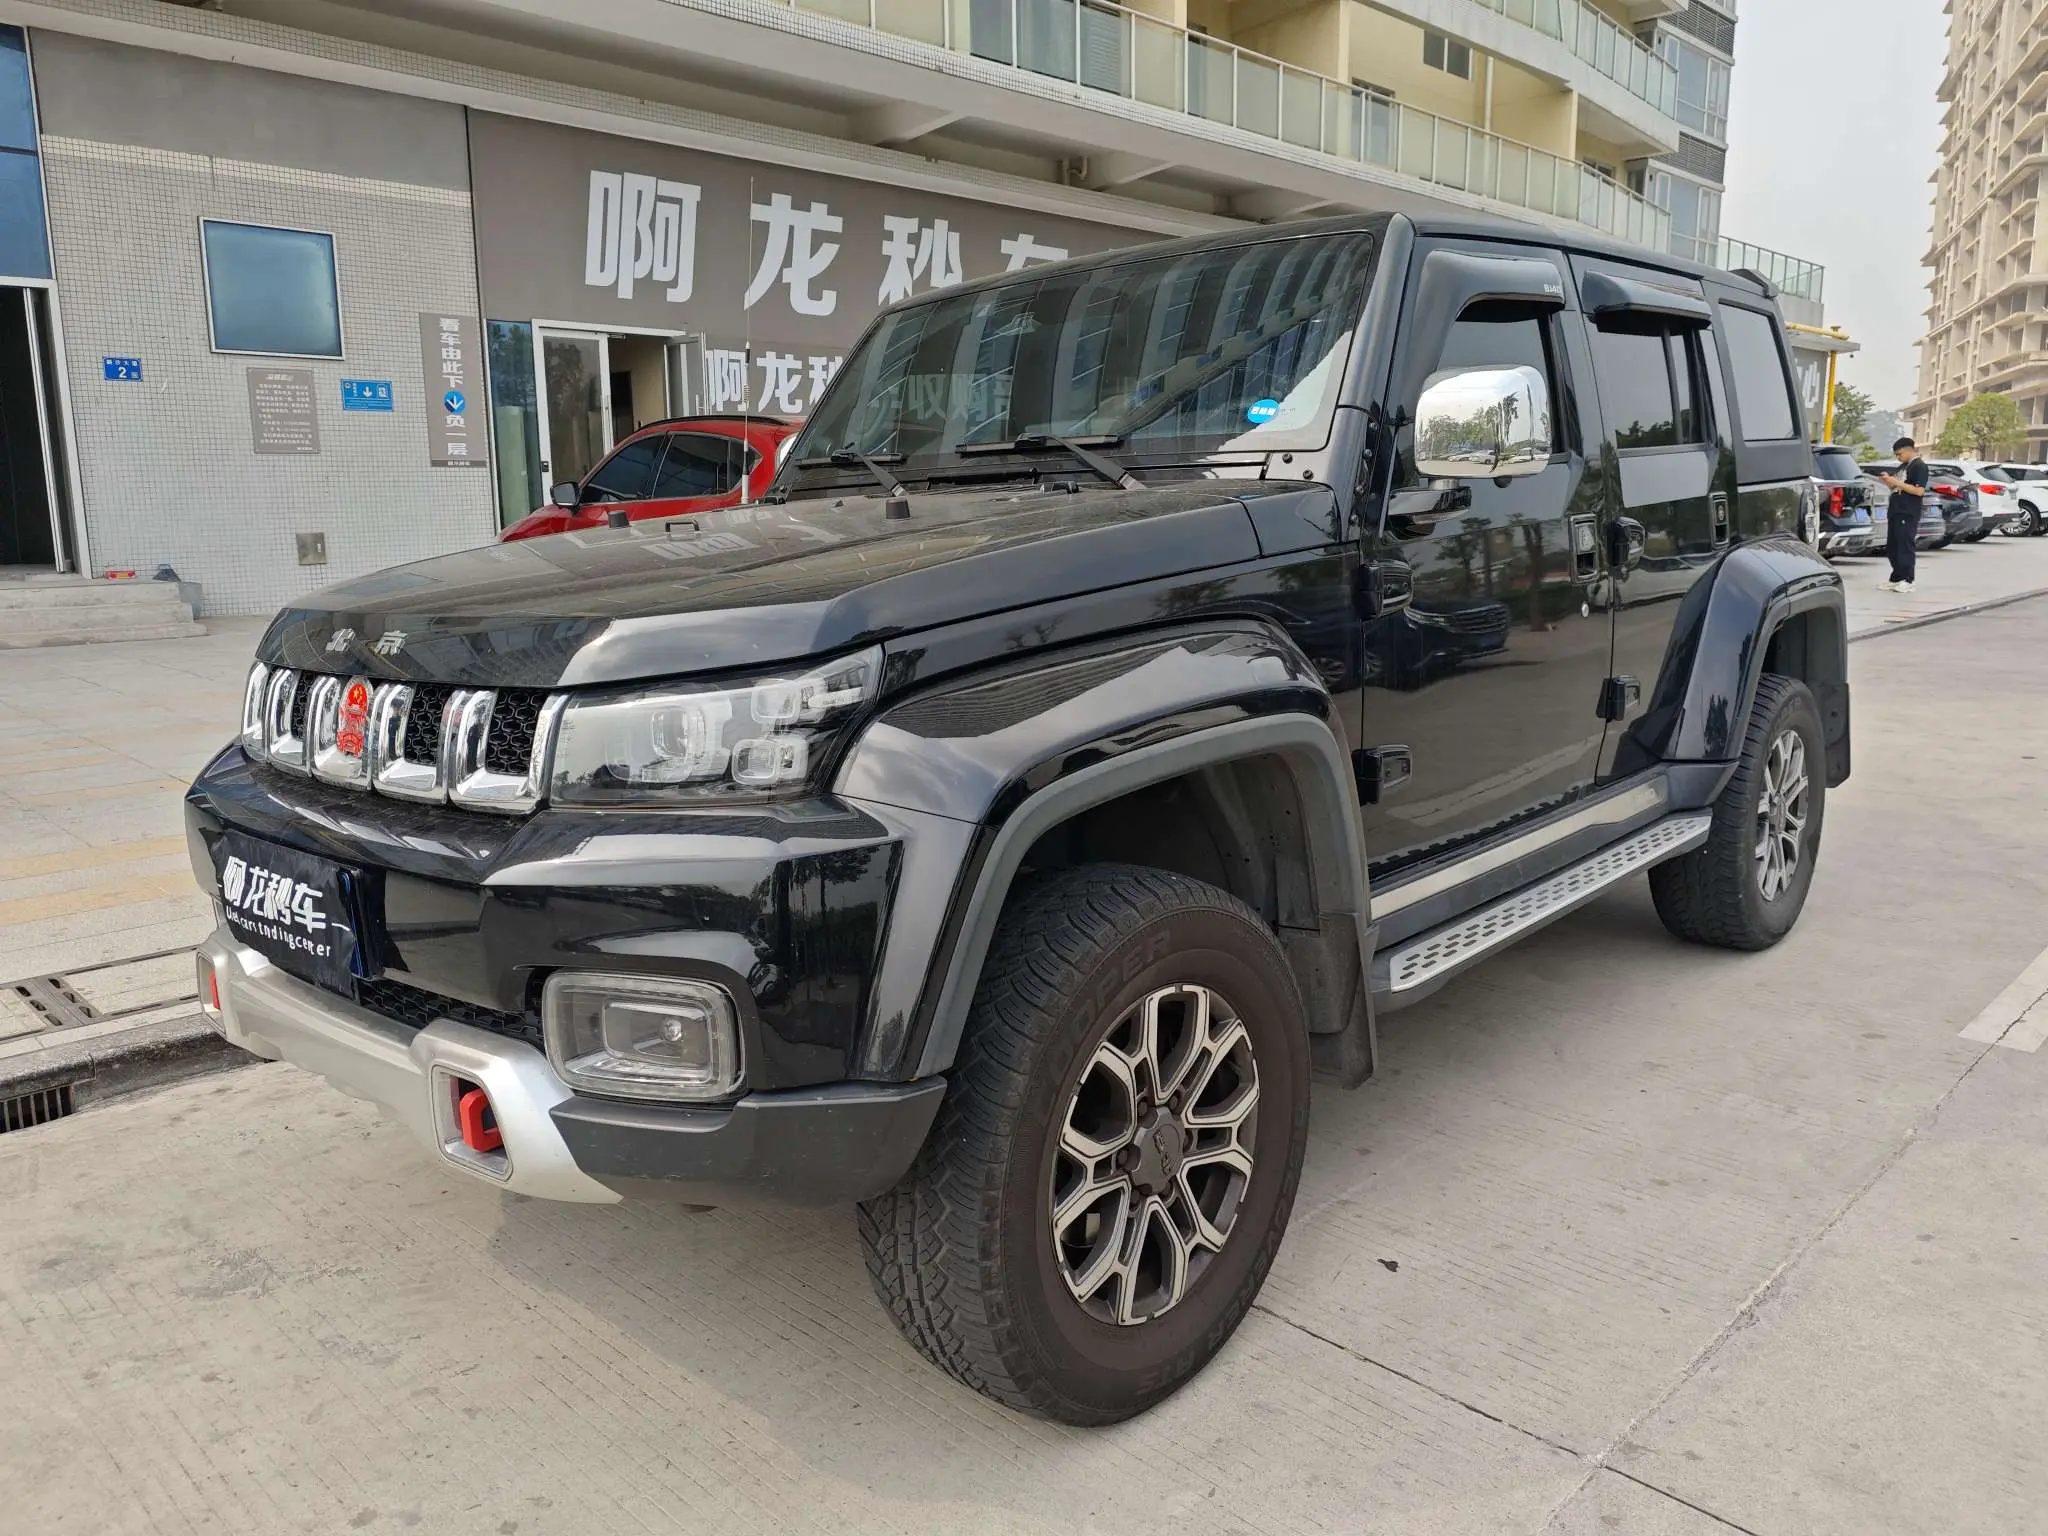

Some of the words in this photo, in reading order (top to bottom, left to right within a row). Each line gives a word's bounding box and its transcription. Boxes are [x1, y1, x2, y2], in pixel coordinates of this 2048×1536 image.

[439, 317, 464, 388] 看车由此下
[118, 366, 127, 378] 2
[445, 414, 468, 455] 负一层
[325, 628, 408, 656] 北京
